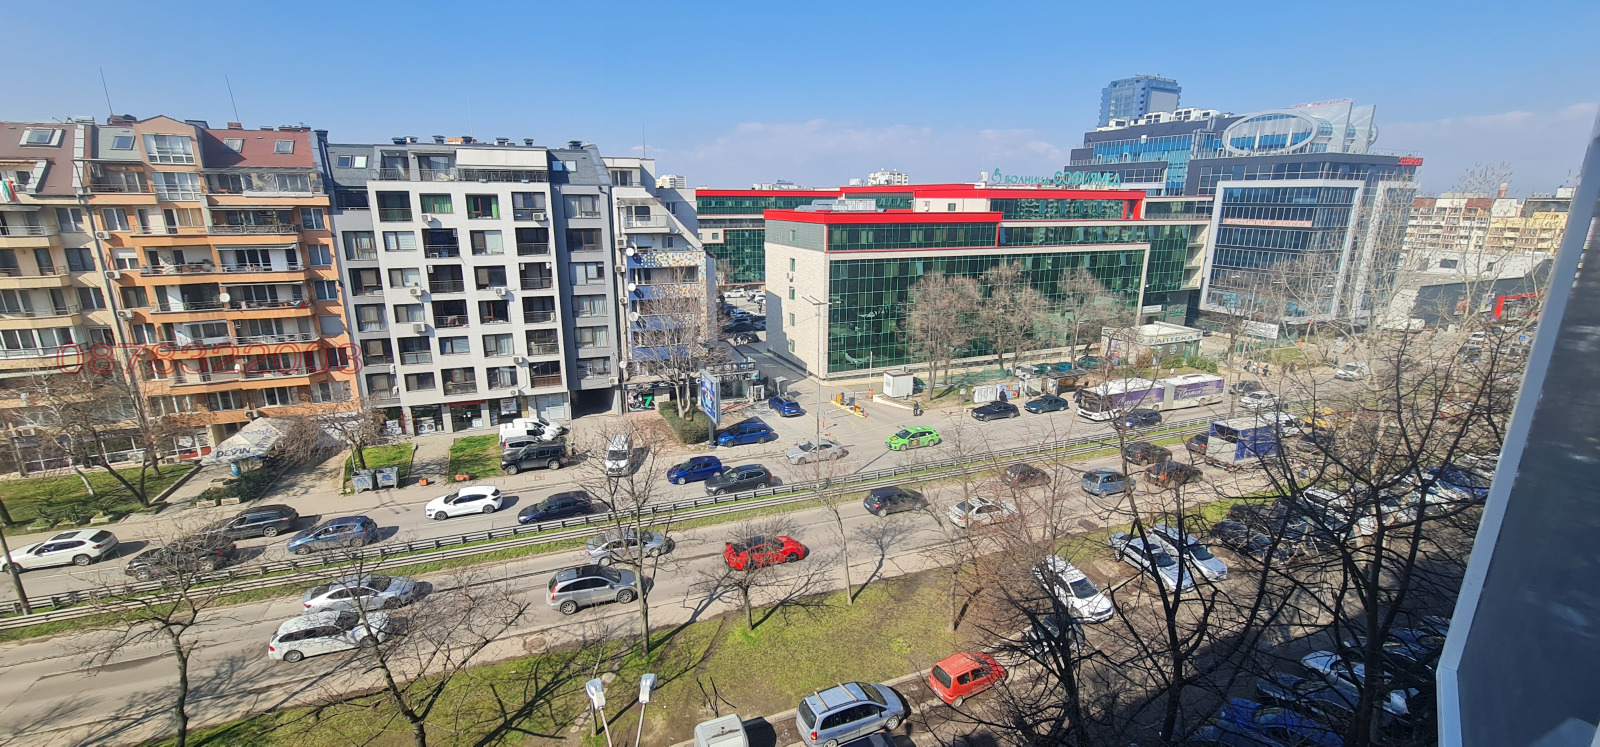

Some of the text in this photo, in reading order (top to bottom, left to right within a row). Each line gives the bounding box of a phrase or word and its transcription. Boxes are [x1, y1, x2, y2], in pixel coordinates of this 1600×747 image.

[1005, 170, 1122, 187] БОЛНИЦА СОФИЯМЕД
[1155, 335, 1194, 344] АПТЕКА
[216, 447, 251, 459] DEVIN
